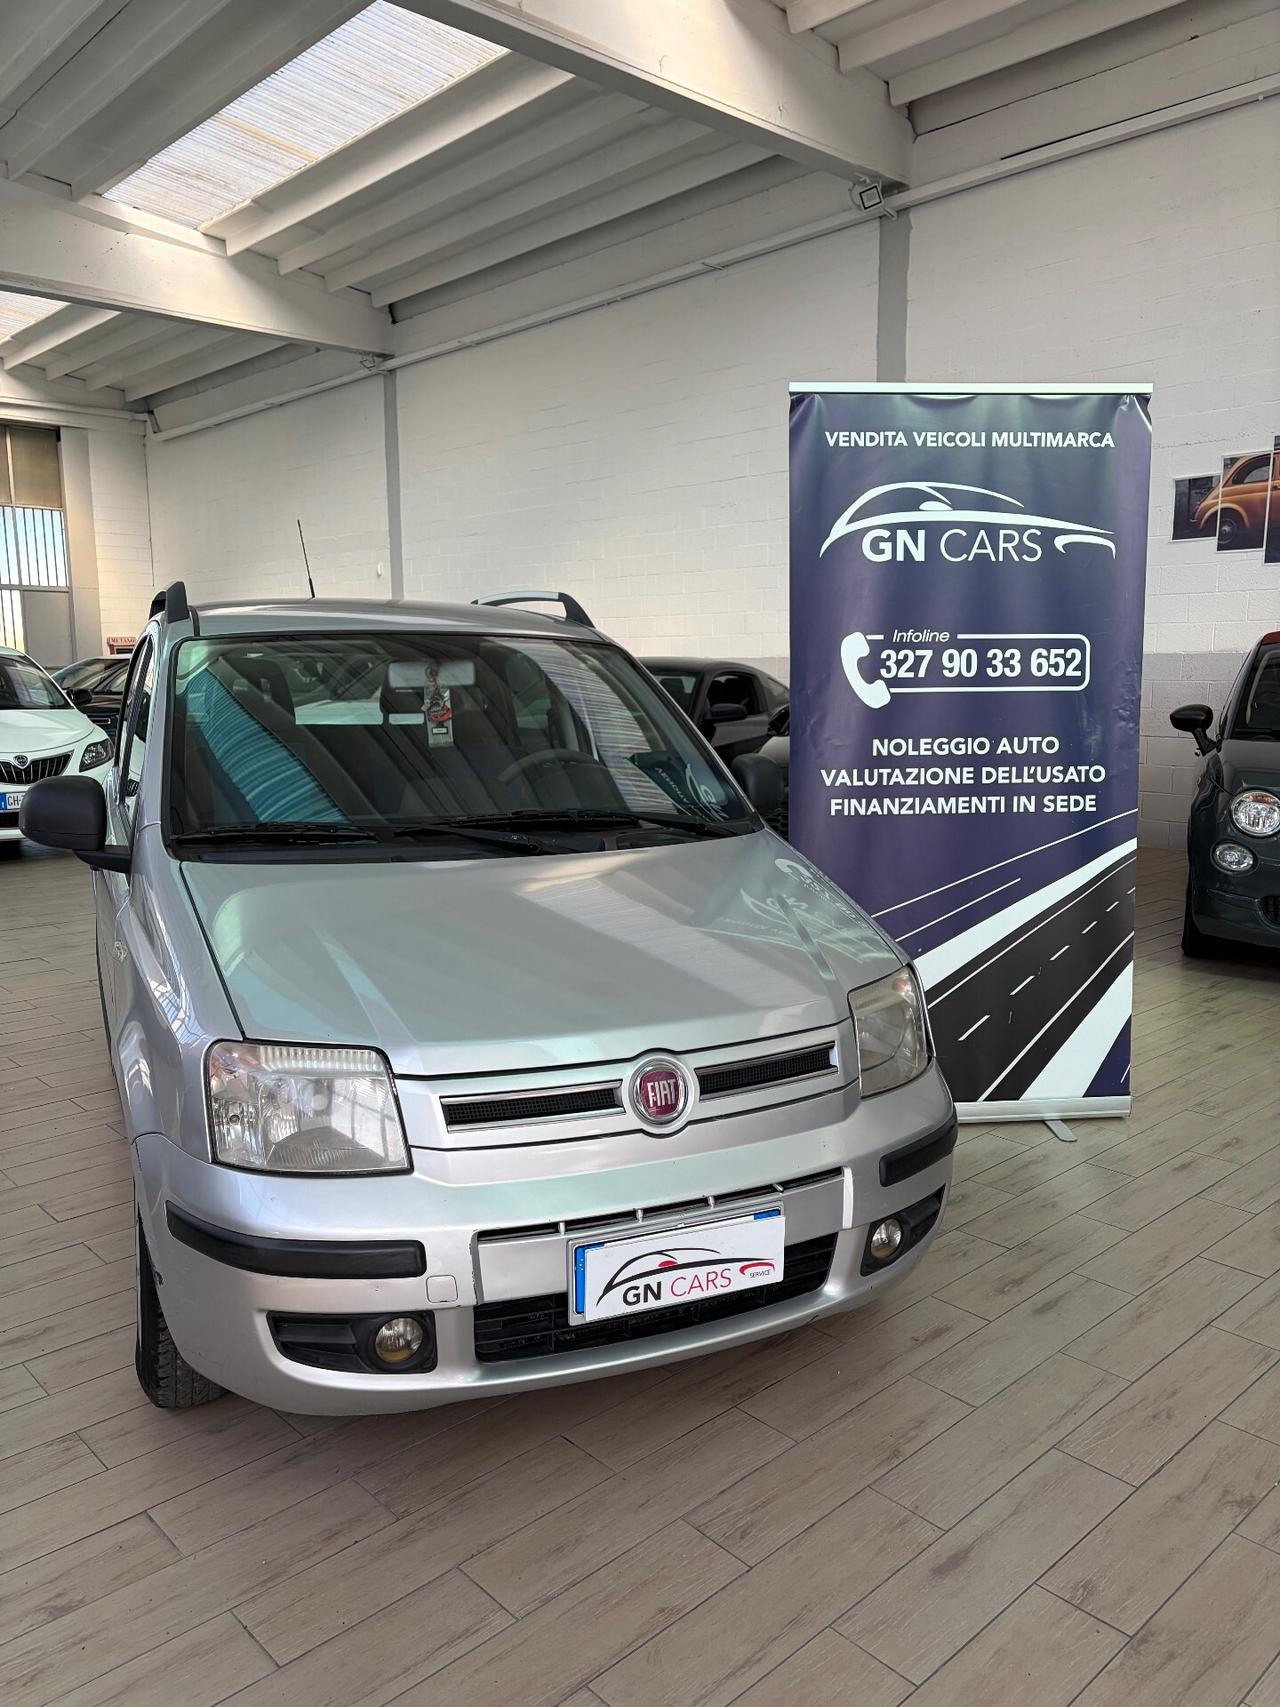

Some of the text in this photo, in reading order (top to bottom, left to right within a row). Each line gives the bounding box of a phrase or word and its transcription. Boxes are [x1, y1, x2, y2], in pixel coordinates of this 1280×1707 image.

[825, 431, 1116, 448] VENDITA VEICOLI MULTIMARCA
[861, 528, 1042, 562] GN CARS
[892, 629, 950, 643] Infoline
[880, 648, 1082, 678] 327 90 33 652
[872, 736, 1060, 756] NOLEGGIO AUTO
[821, 767, 974, 787] VALUTAZIONE
[830, 794, 1097, 816] FINANZIAMENTI IN SEDE
[647, 1078, 676, 1108] FIAT
[622, 1281, 662, 1306] GN
[670, 1268, 732, 1297] CARS
